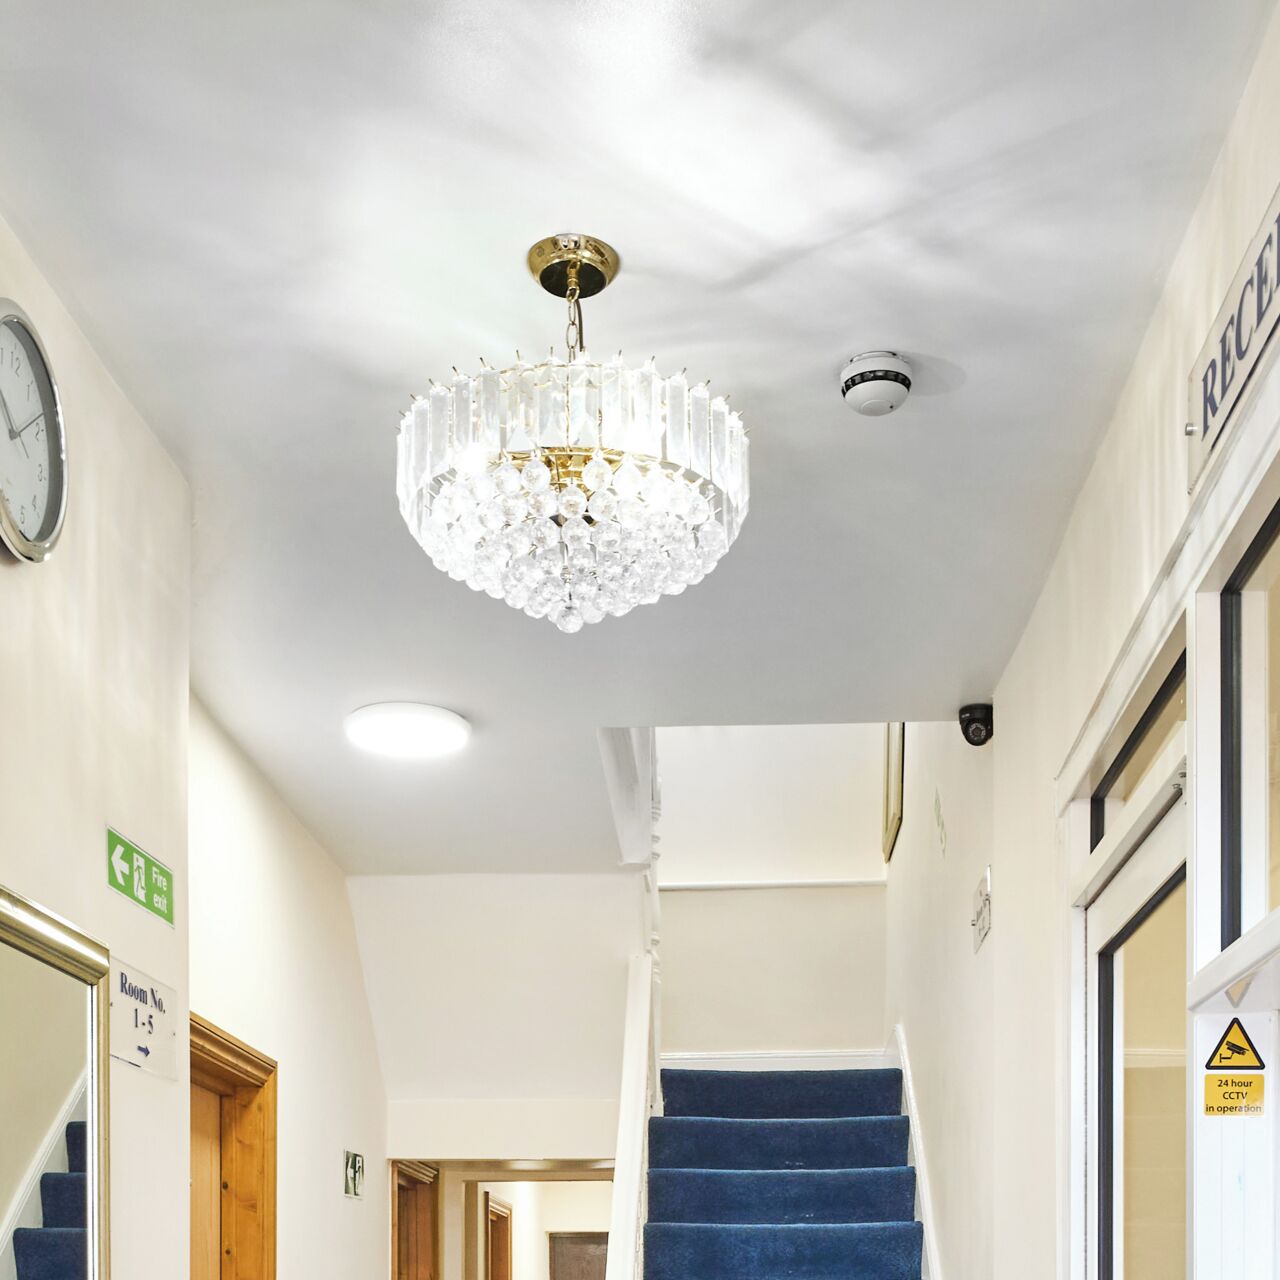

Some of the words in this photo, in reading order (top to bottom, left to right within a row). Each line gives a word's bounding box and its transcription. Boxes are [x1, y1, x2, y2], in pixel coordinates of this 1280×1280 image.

[152, 866, 167, 891] Fire
[153, 892, 167, 913] exit
[120, 971, 148, 1005] Room
[151, 987, 166, 1014] No.
[1232, 1079, 1253, 1087] hour
[1223, 1092, 1248, 1100] CCTV
[1206, 1104, 1214, 1112] in
[1217, 1104, 1262, 1114] operation
